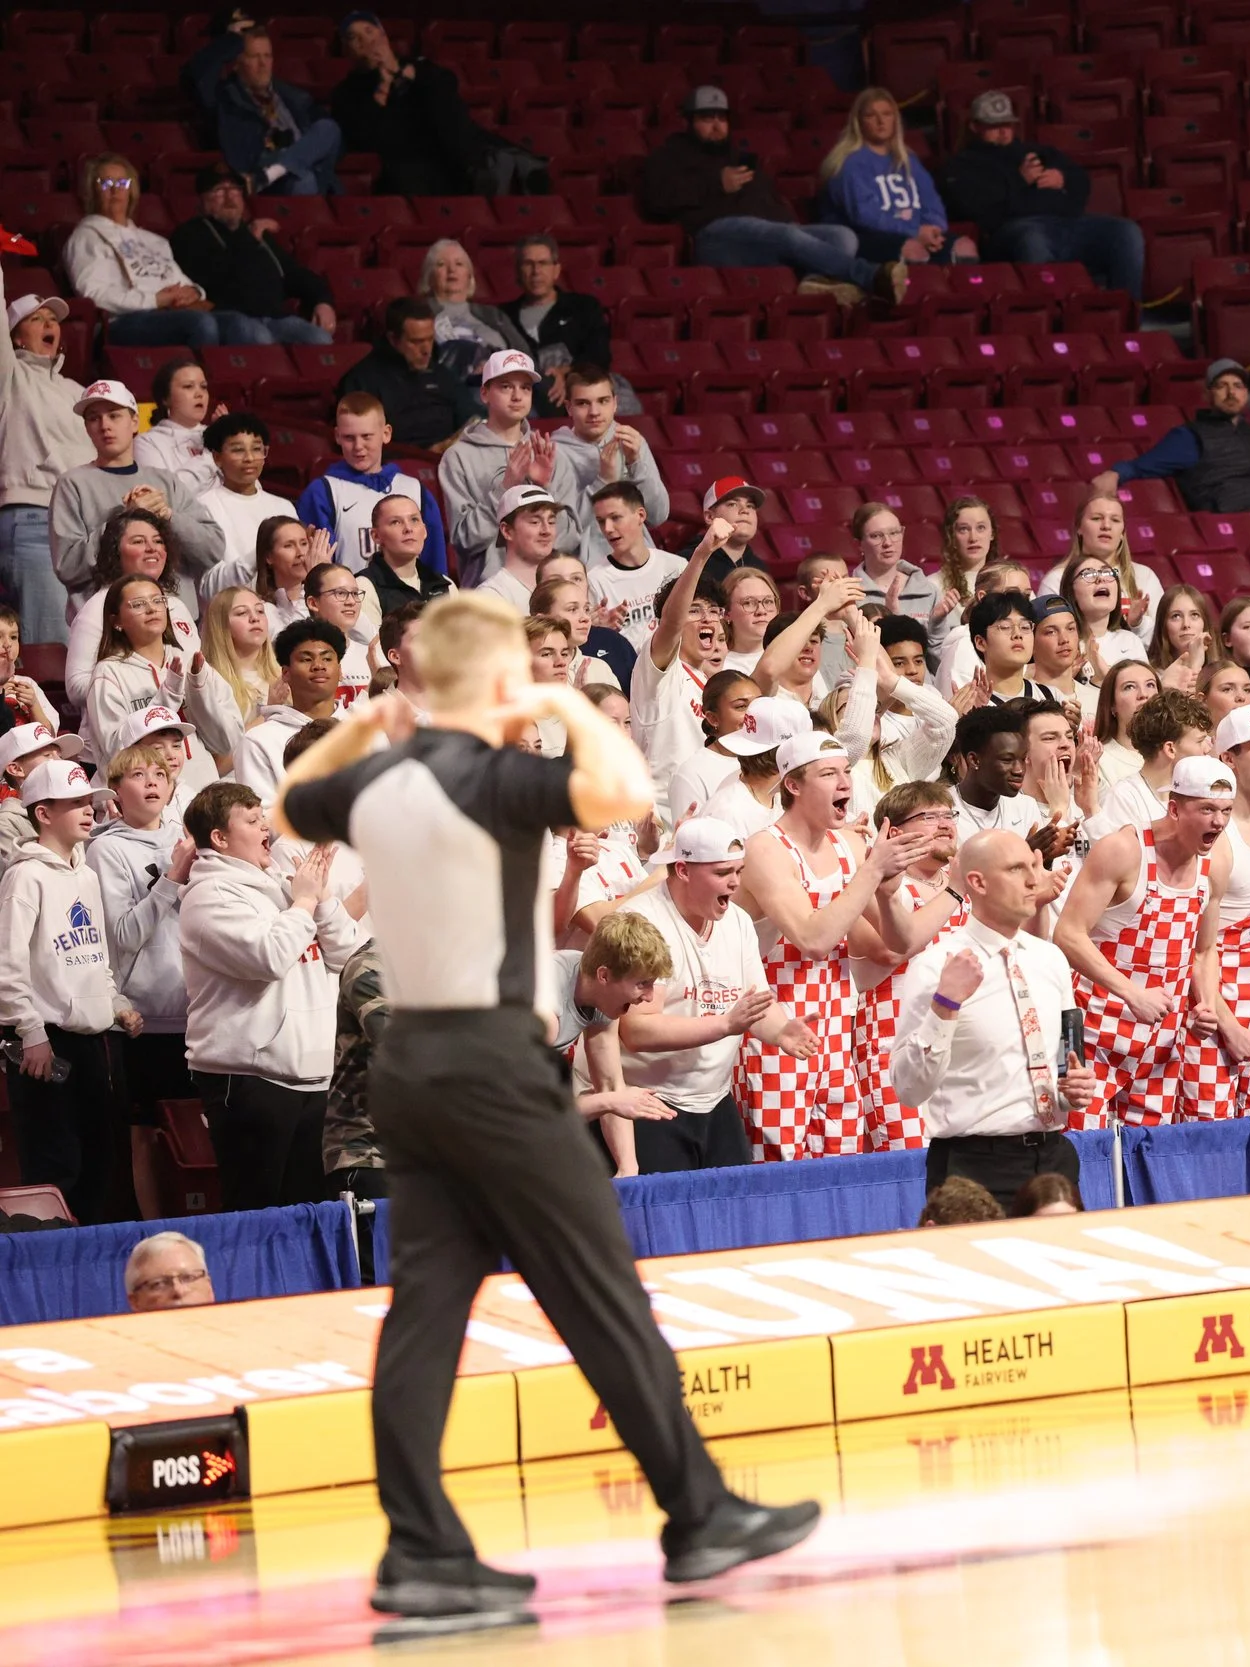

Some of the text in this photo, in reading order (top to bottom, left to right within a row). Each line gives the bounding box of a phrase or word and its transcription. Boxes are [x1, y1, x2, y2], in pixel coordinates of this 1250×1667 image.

[963, 1331, 1054, 1367] HEALTH
[0, 1360, 377, 1428] aborer
[964, 1368, 1029, 1389] FAIRVIEW
[152, 1455, 201, 1489] POSS
